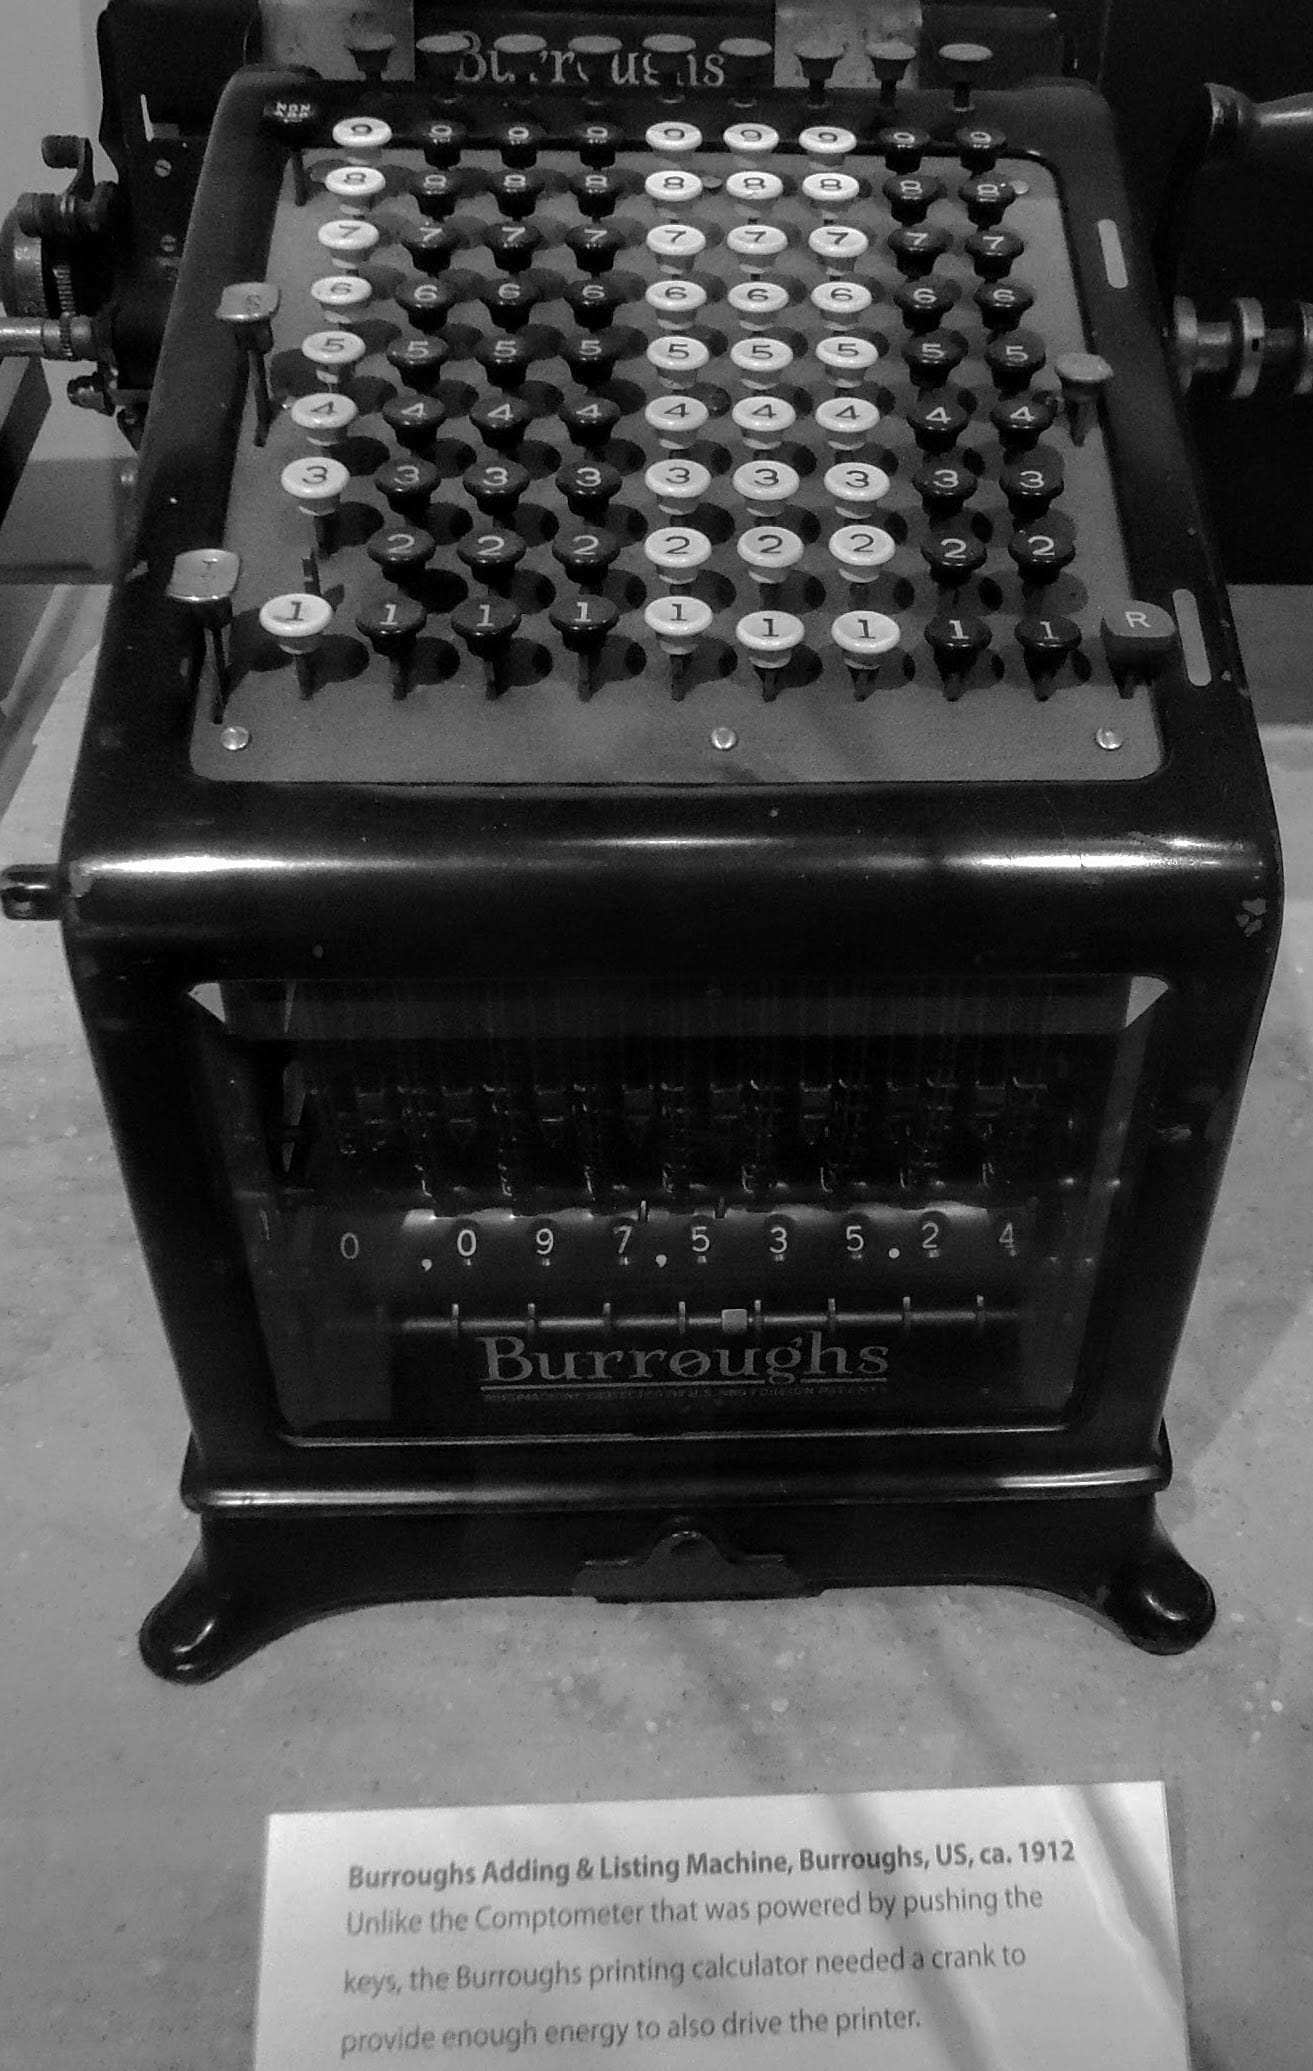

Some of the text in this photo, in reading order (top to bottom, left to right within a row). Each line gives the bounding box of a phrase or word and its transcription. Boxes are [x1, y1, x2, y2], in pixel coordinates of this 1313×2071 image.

[454, 30, 726, 88] Burus
[425, 175, 446, 188] 8
[504, 174, 526, 188] 8
[585, 174, 607, 188] 8
[664, 176, 684, 189] 8
[743, 177, 765, 190] 8
[820, 179, 841, 191] 8
[900, 180, 922, 195] 8
[977, 184, 998, 196] 8
[339, 225, 1005, 250] 7 7 7 7 7 7 7 7 7
[330, 282, 1016, 303] 6 6 6 6 6 6 6 6 6
[323, 338, 1029, 362] 5 5 5 5 5 5 5 5 5
[310, 402, 1034, 424] 4 4 4 4 4 4 4 4 4
[302, 466, 1044, 489] 3 3 3 3 3 3 3 3 3
[388, 534, 1055, 558] 2 2 2 2 2 2 2 2
[286, 602, 1059, 639] 1 1 1 1 1 1 1 1 1
[1125, 611, 1151, 628] R
[475, 1331, 889, 1386] Burroughs
[349, 1840, 1075, 1891] Burroughs Adding & Listing Machine, Burroughs, US, ca. 1912
[347, 1884, 1043, 1936] Unlike the Comptometer that was powered by pushing the
[344, 1942, 1026, 1999] keys, the Burroughs printing calculator needed a crank to
[341, 2007, 921, 2060] provide enough energy to also drive the printer.
